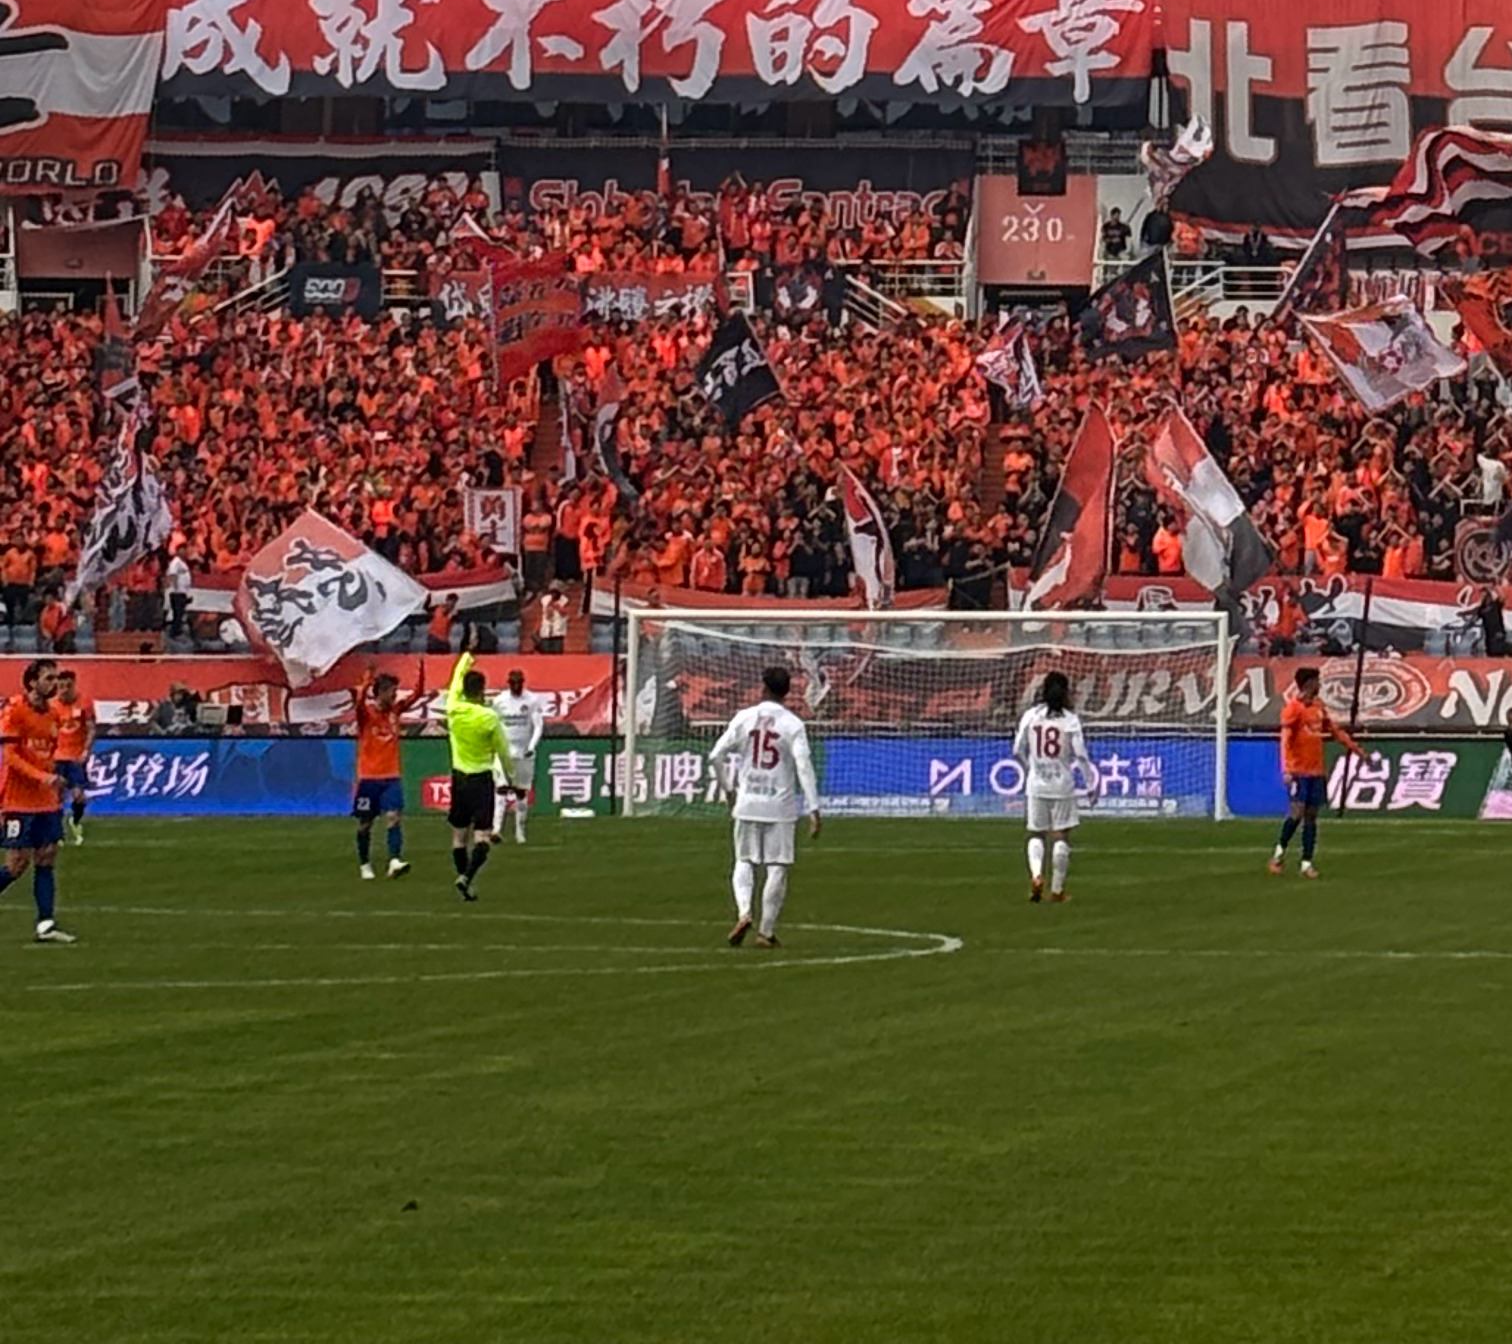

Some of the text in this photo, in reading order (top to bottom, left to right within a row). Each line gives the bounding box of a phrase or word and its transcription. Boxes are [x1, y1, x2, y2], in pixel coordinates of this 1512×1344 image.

[0, 161, 118, 186] ORLD
[1002, 215, 1063, 241] 230
[748, 728, 781, 770] 15
[1032, 725, 1061, 759] 18
[356, 796, 371, 811] 22
